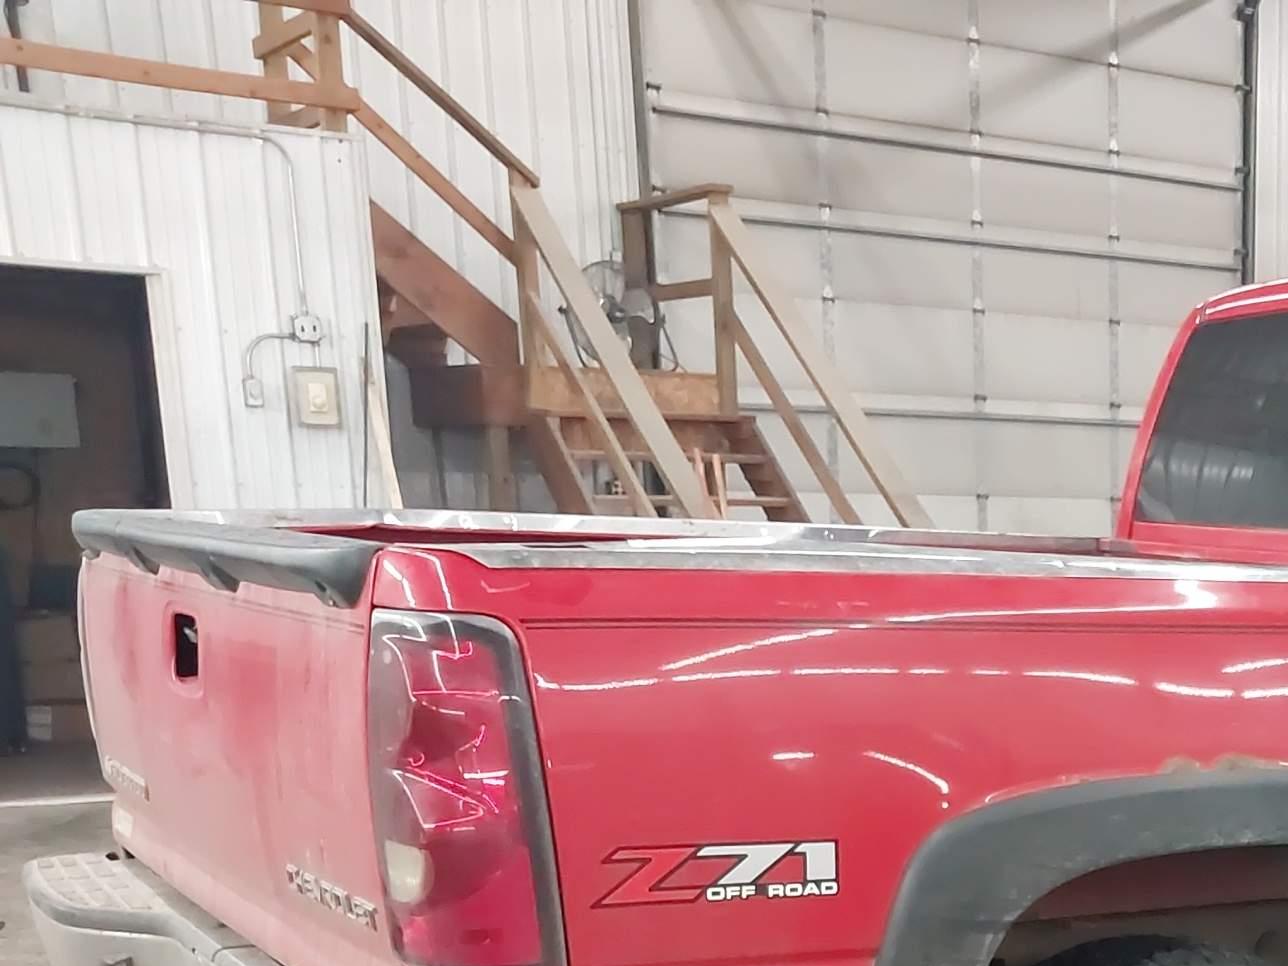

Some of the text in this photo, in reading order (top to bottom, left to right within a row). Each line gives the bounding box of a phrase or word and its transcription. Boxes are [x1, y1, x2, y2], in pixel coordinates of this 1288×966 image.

[590, 840, 839, 909] Z71
[706, 881, 839, 902] OFF ROAD
